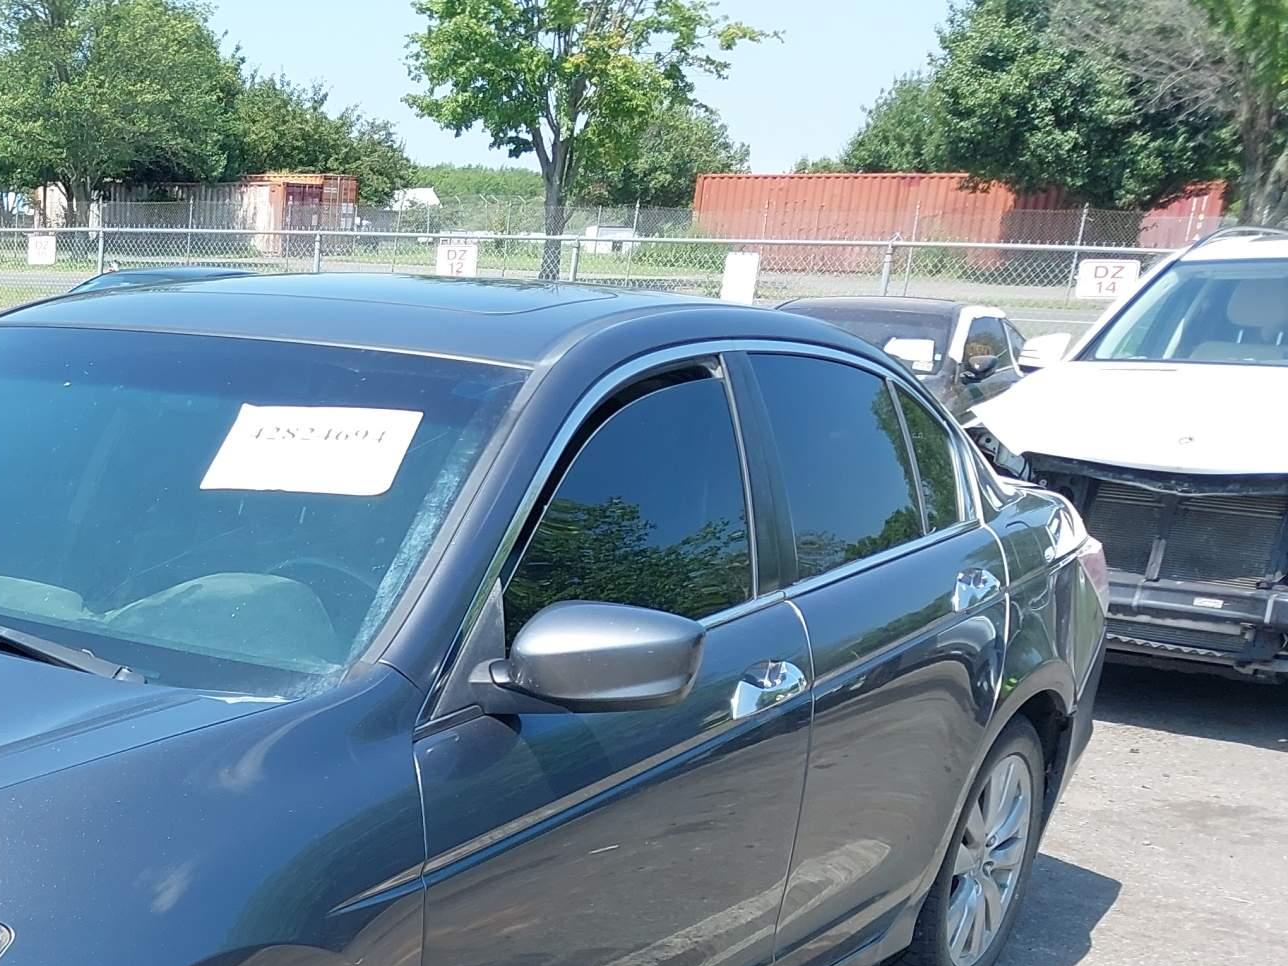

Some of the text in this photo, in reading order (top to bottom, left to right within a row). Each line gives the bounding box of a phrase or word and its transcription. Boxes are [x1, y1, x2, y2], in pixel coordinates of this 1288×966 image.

[447, 249, 468, 261] DZ
[448, 261, 464, 275] 12
[1094, 265, 1125, 279] DZ
[1096, 281, 1117, 293] 14
